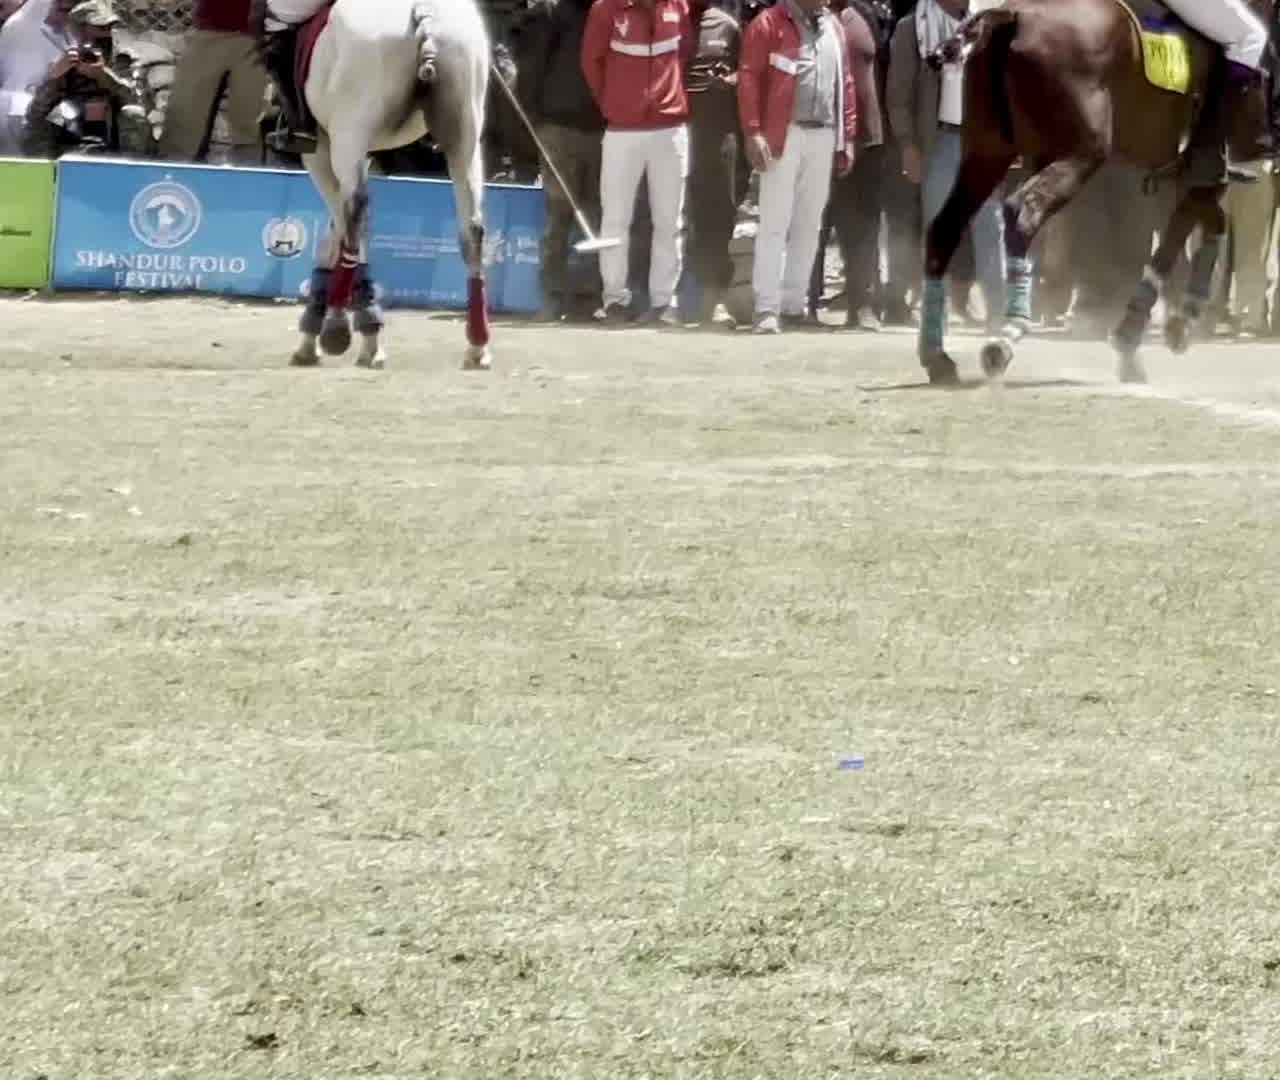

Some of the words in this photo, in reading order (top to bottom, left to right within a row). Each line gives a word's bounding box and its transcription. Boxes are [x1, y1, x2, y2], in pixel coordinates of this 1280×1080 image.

[75, 250, 182, 271] SHANDUR
[189, 255, 246, 273] POLO
[113, 270, 202, 289] FESTIVAL
